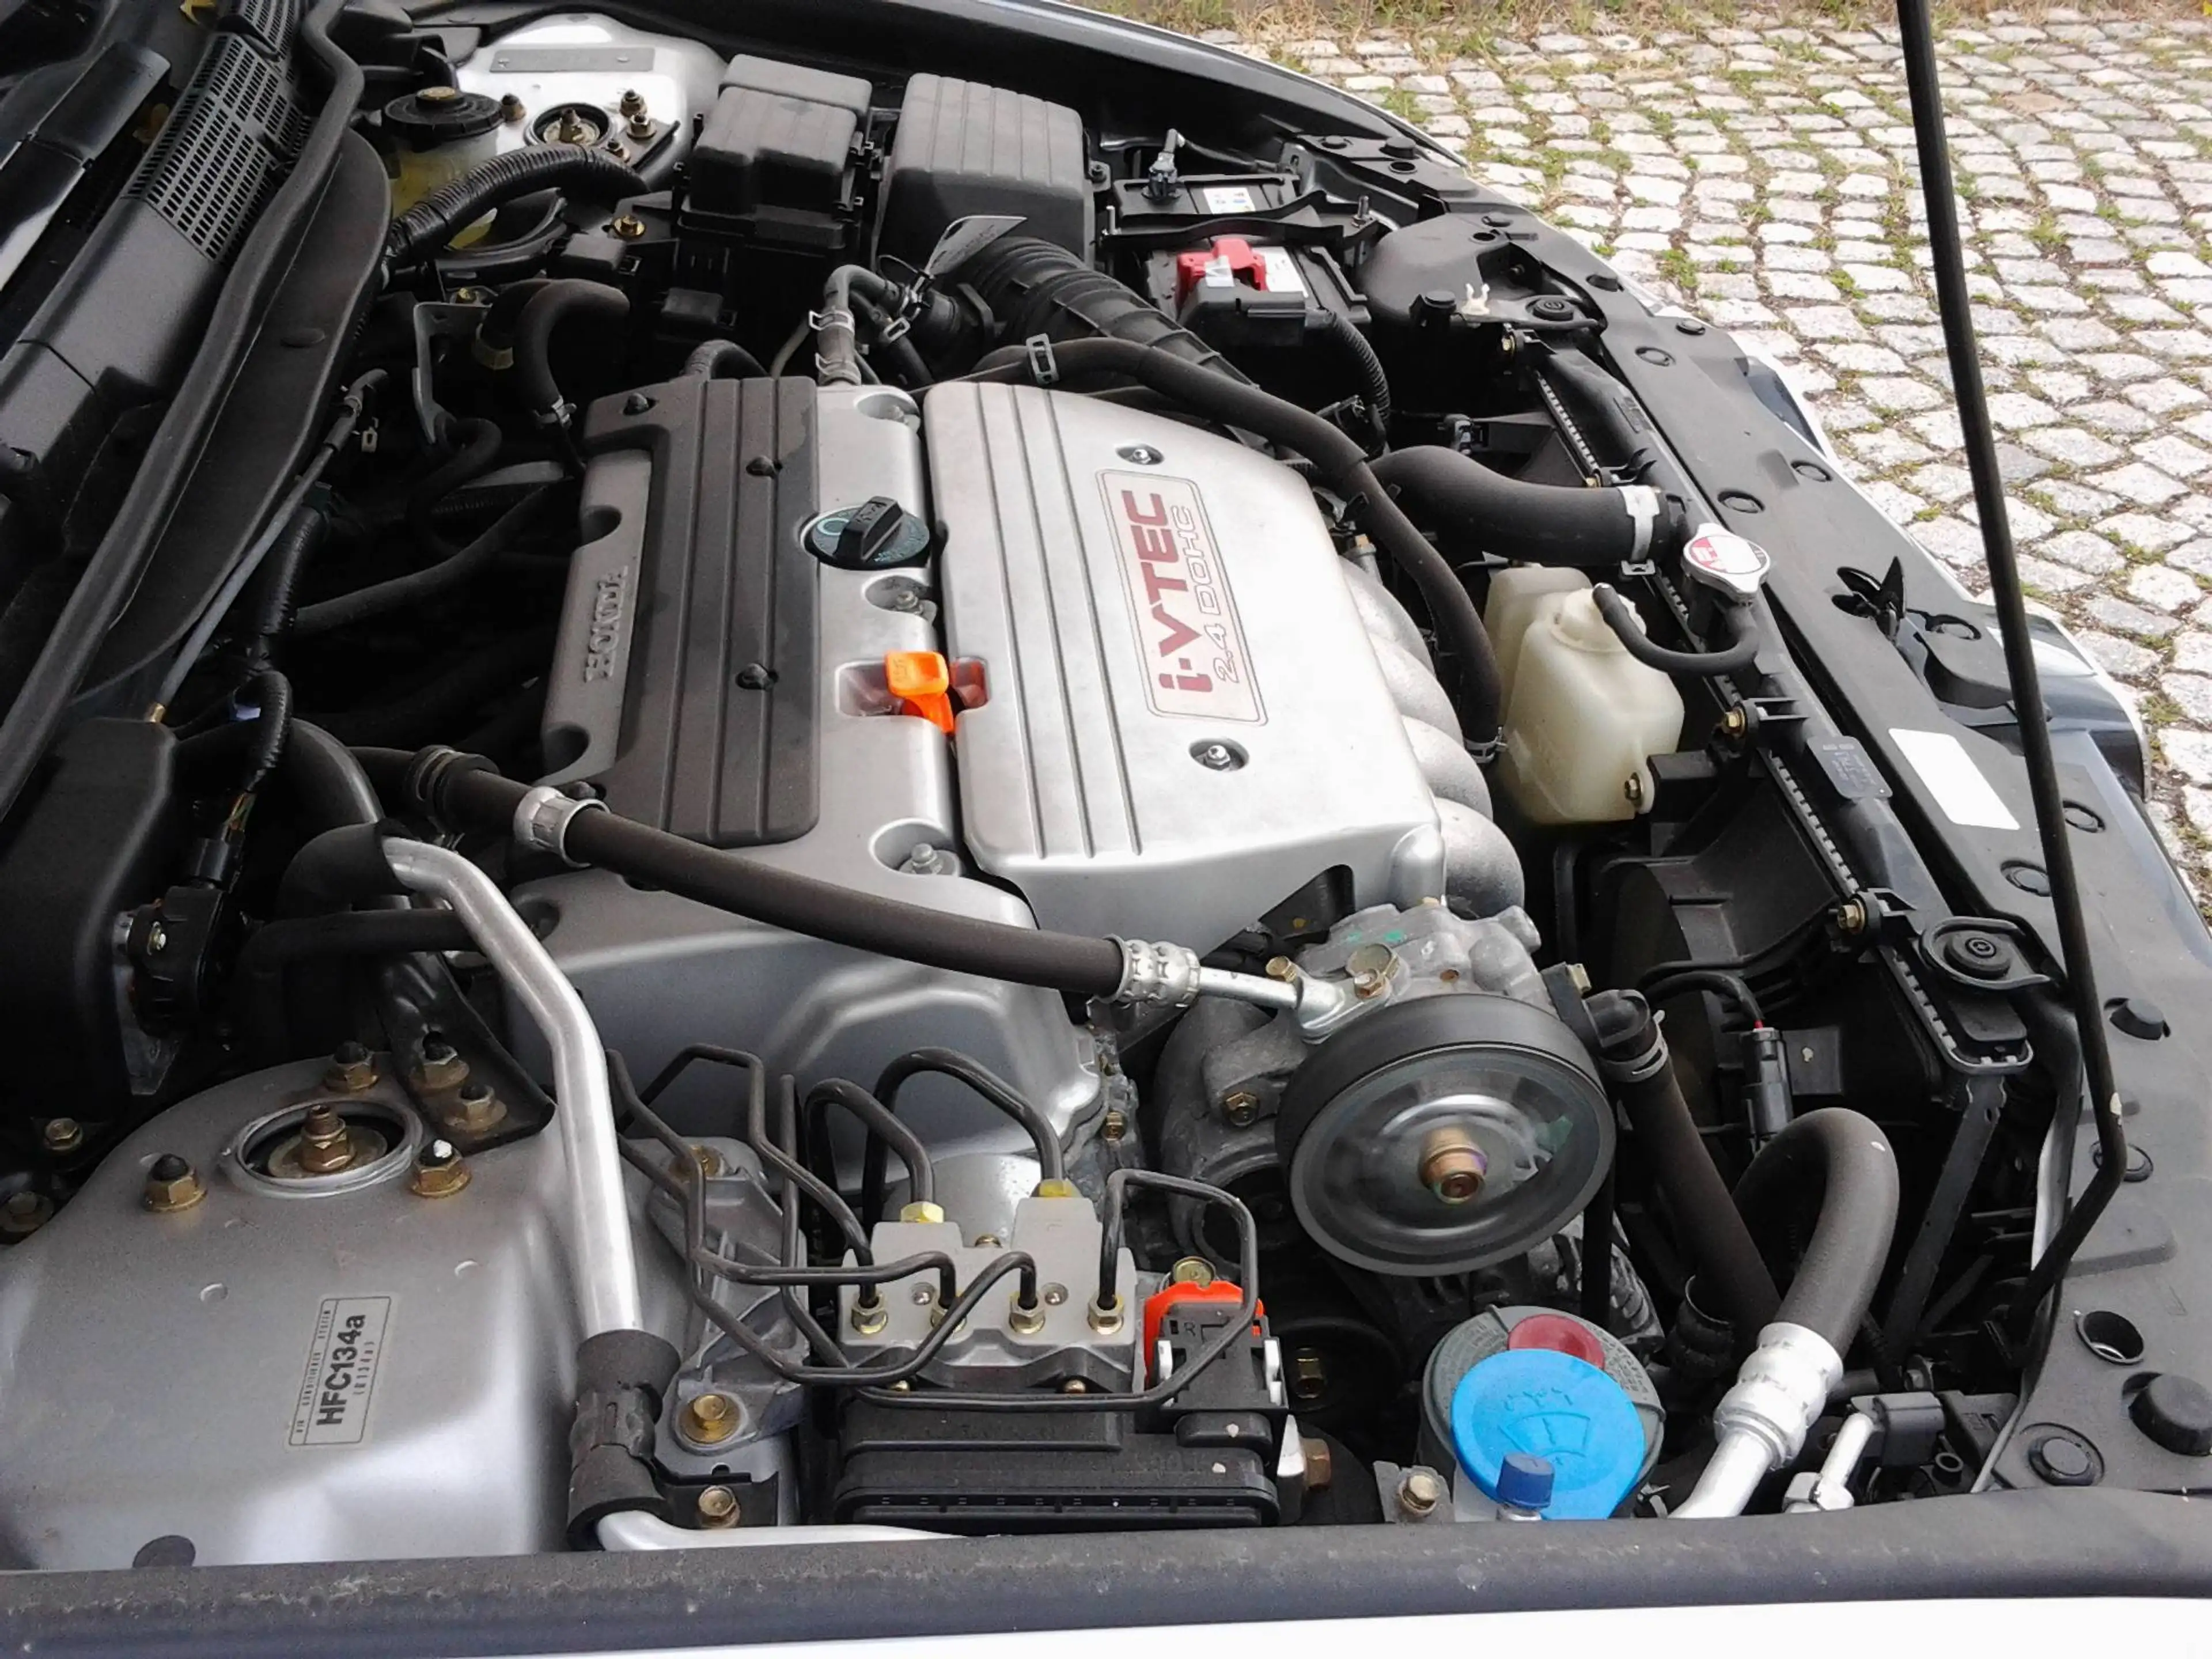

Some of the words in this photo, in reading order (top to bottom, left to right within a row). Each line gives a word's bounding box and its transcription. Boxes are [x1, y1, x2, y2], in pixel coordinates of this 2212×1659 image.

[1121, 490, 1214, 692] i-VTEC
[1171, 505, 1223, 616] DOHC
[584, 565, 629, 683] HONDA
[1203, 623, 1241, 684] 2.4
[316, 1315, 367, 1426] HFC134a
